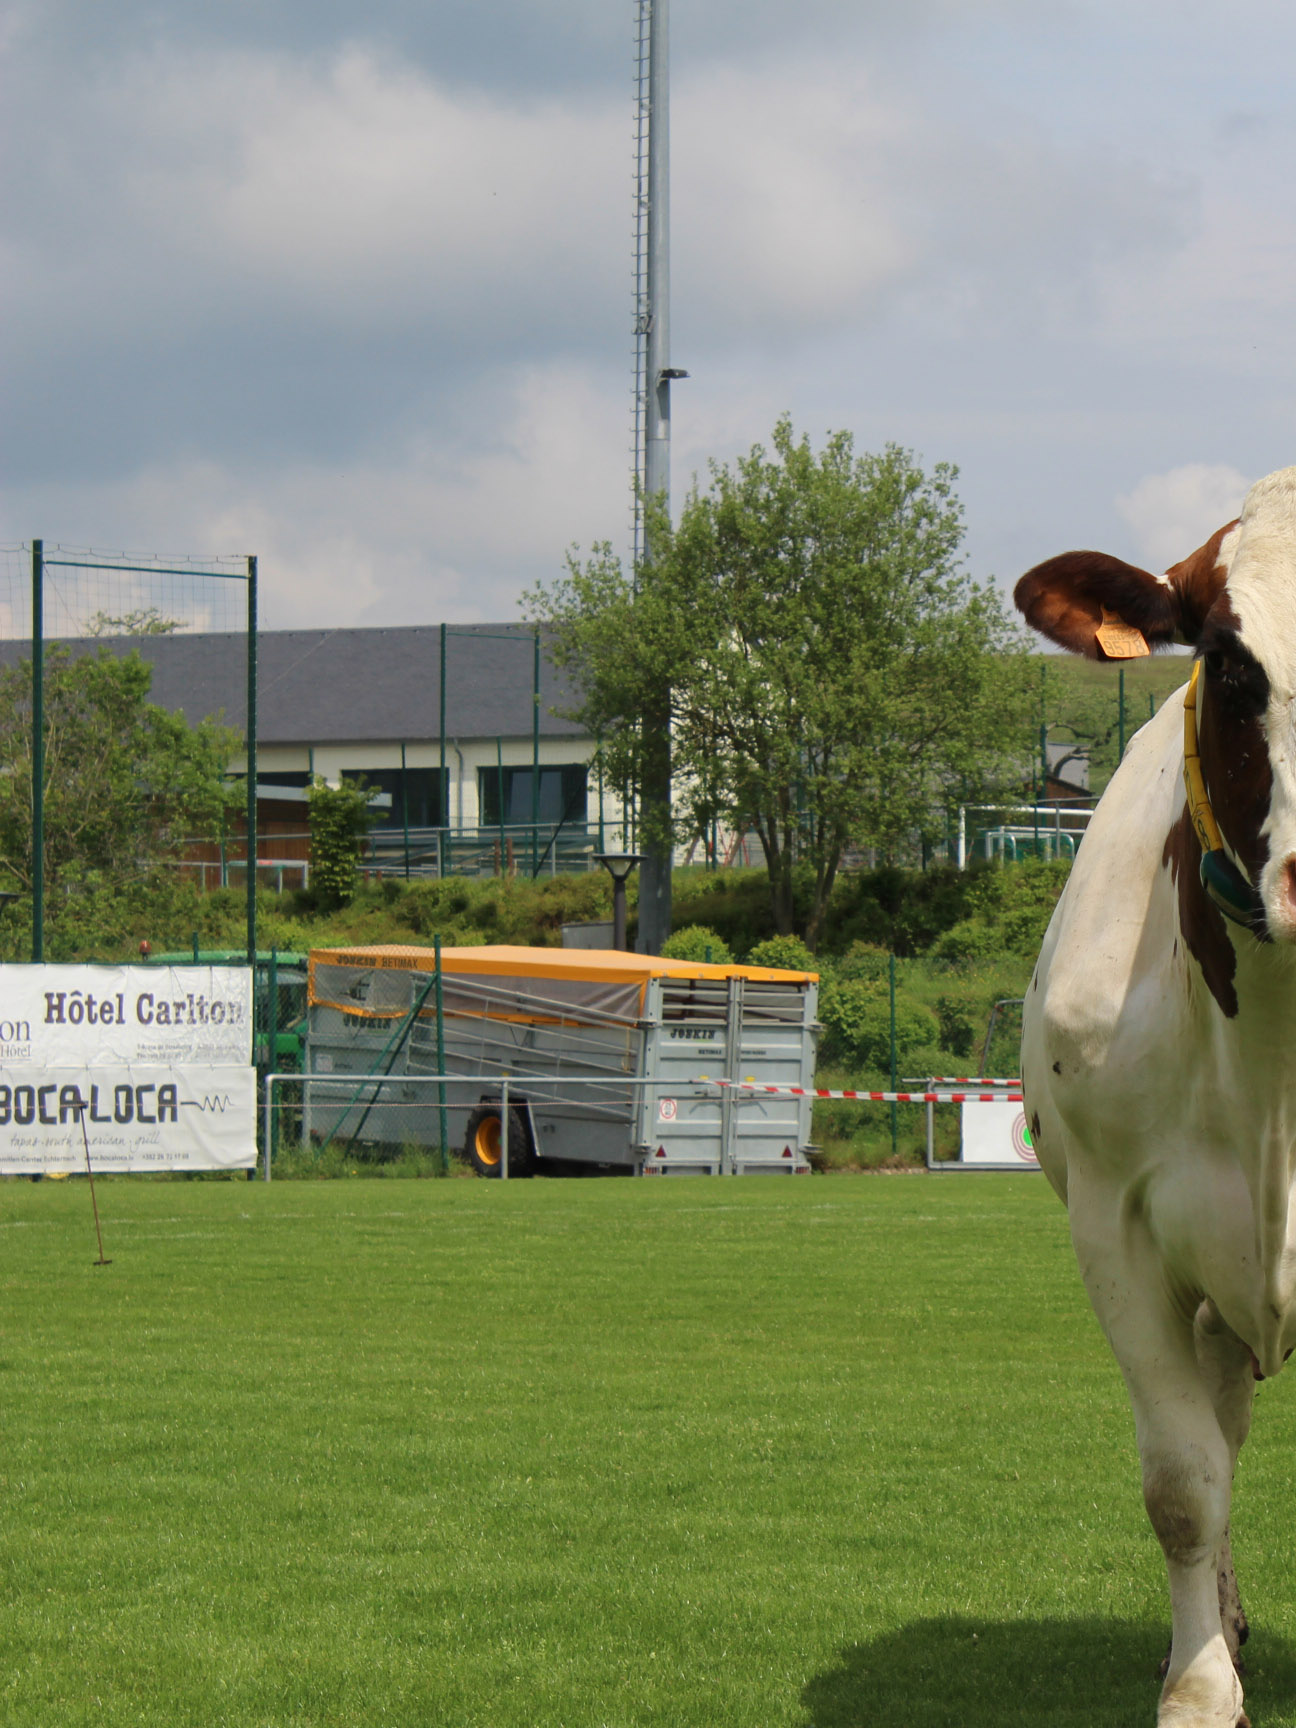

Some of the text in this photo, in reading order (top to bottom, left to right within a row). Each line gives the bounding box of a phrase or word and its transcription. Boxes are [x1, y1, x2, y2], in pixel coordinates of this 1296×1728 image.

[1103, 640, 1146, 656] 9578
[44, 990, 245, 1025] Hôtel Carlton
